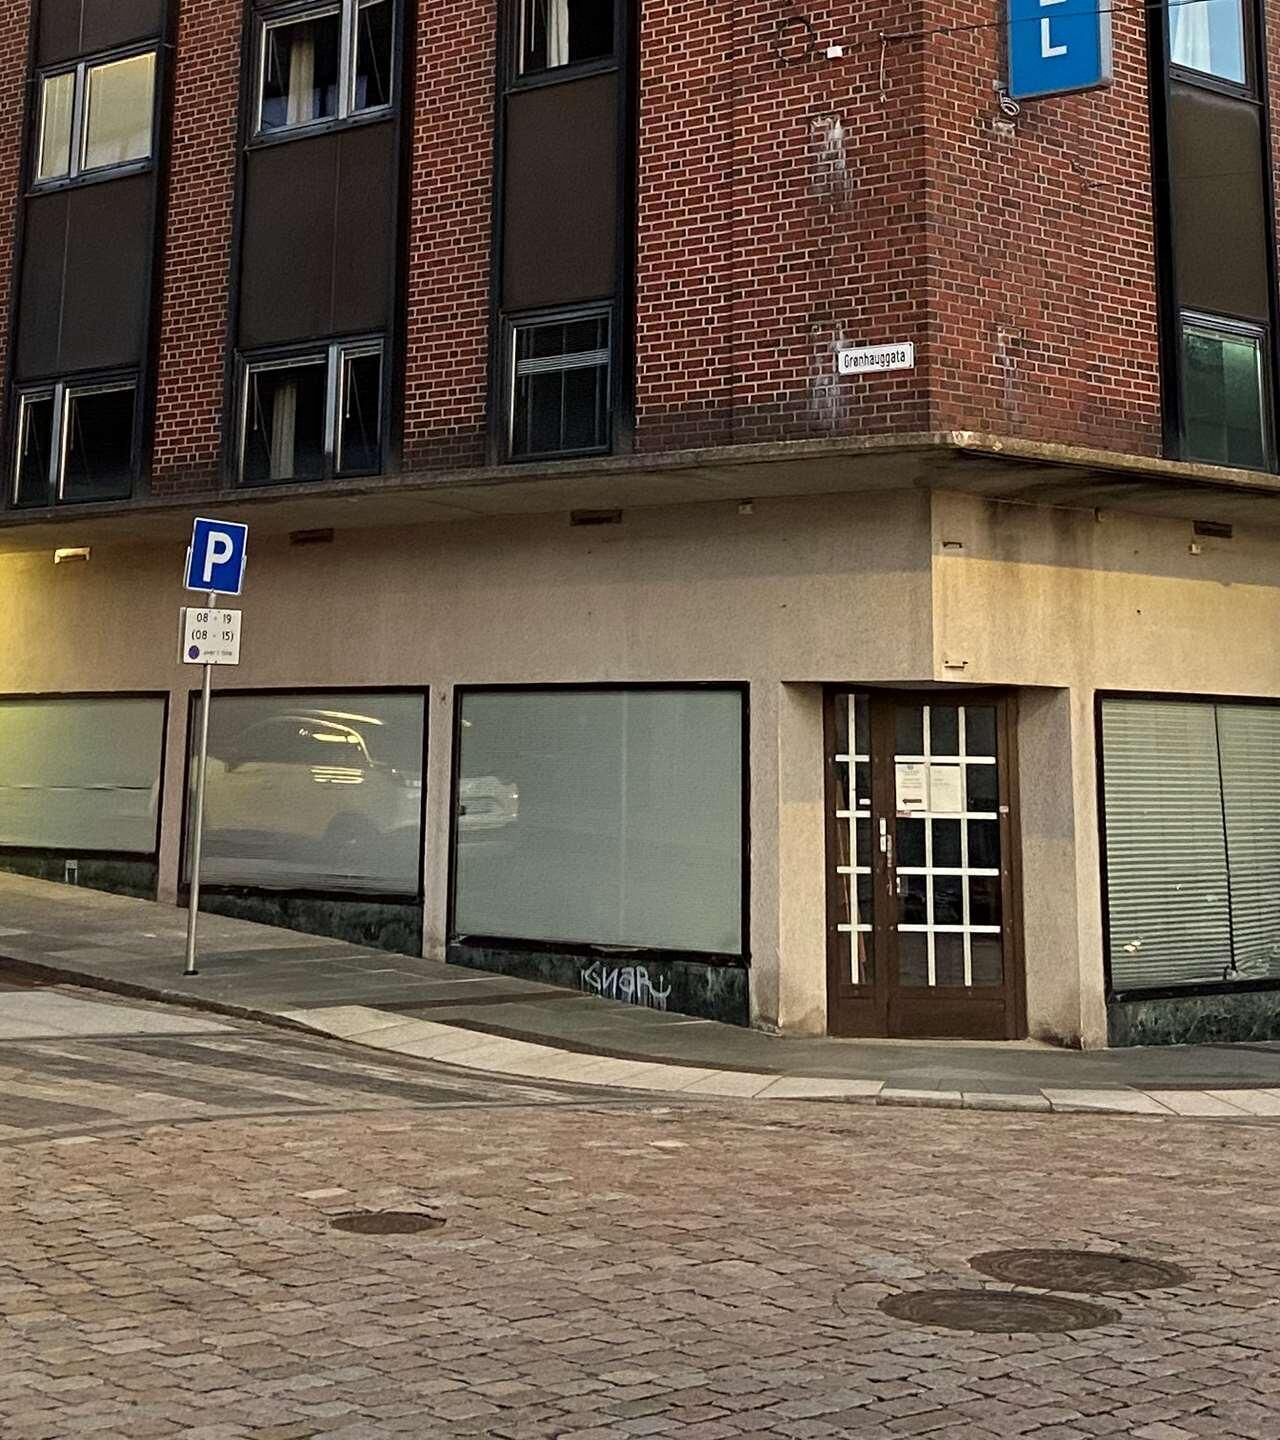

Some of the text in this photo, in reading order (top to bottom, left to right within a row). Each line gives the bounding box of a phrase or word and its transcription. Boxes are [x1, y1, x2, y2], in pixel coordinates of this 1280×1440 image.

[203, 531, 234, 582] P
[196, 613, 209, 623] 08
[223, 613, 232, 624] 19
[191, 630, 208, 640] (08
[222, 631, 234, 642] 15)
